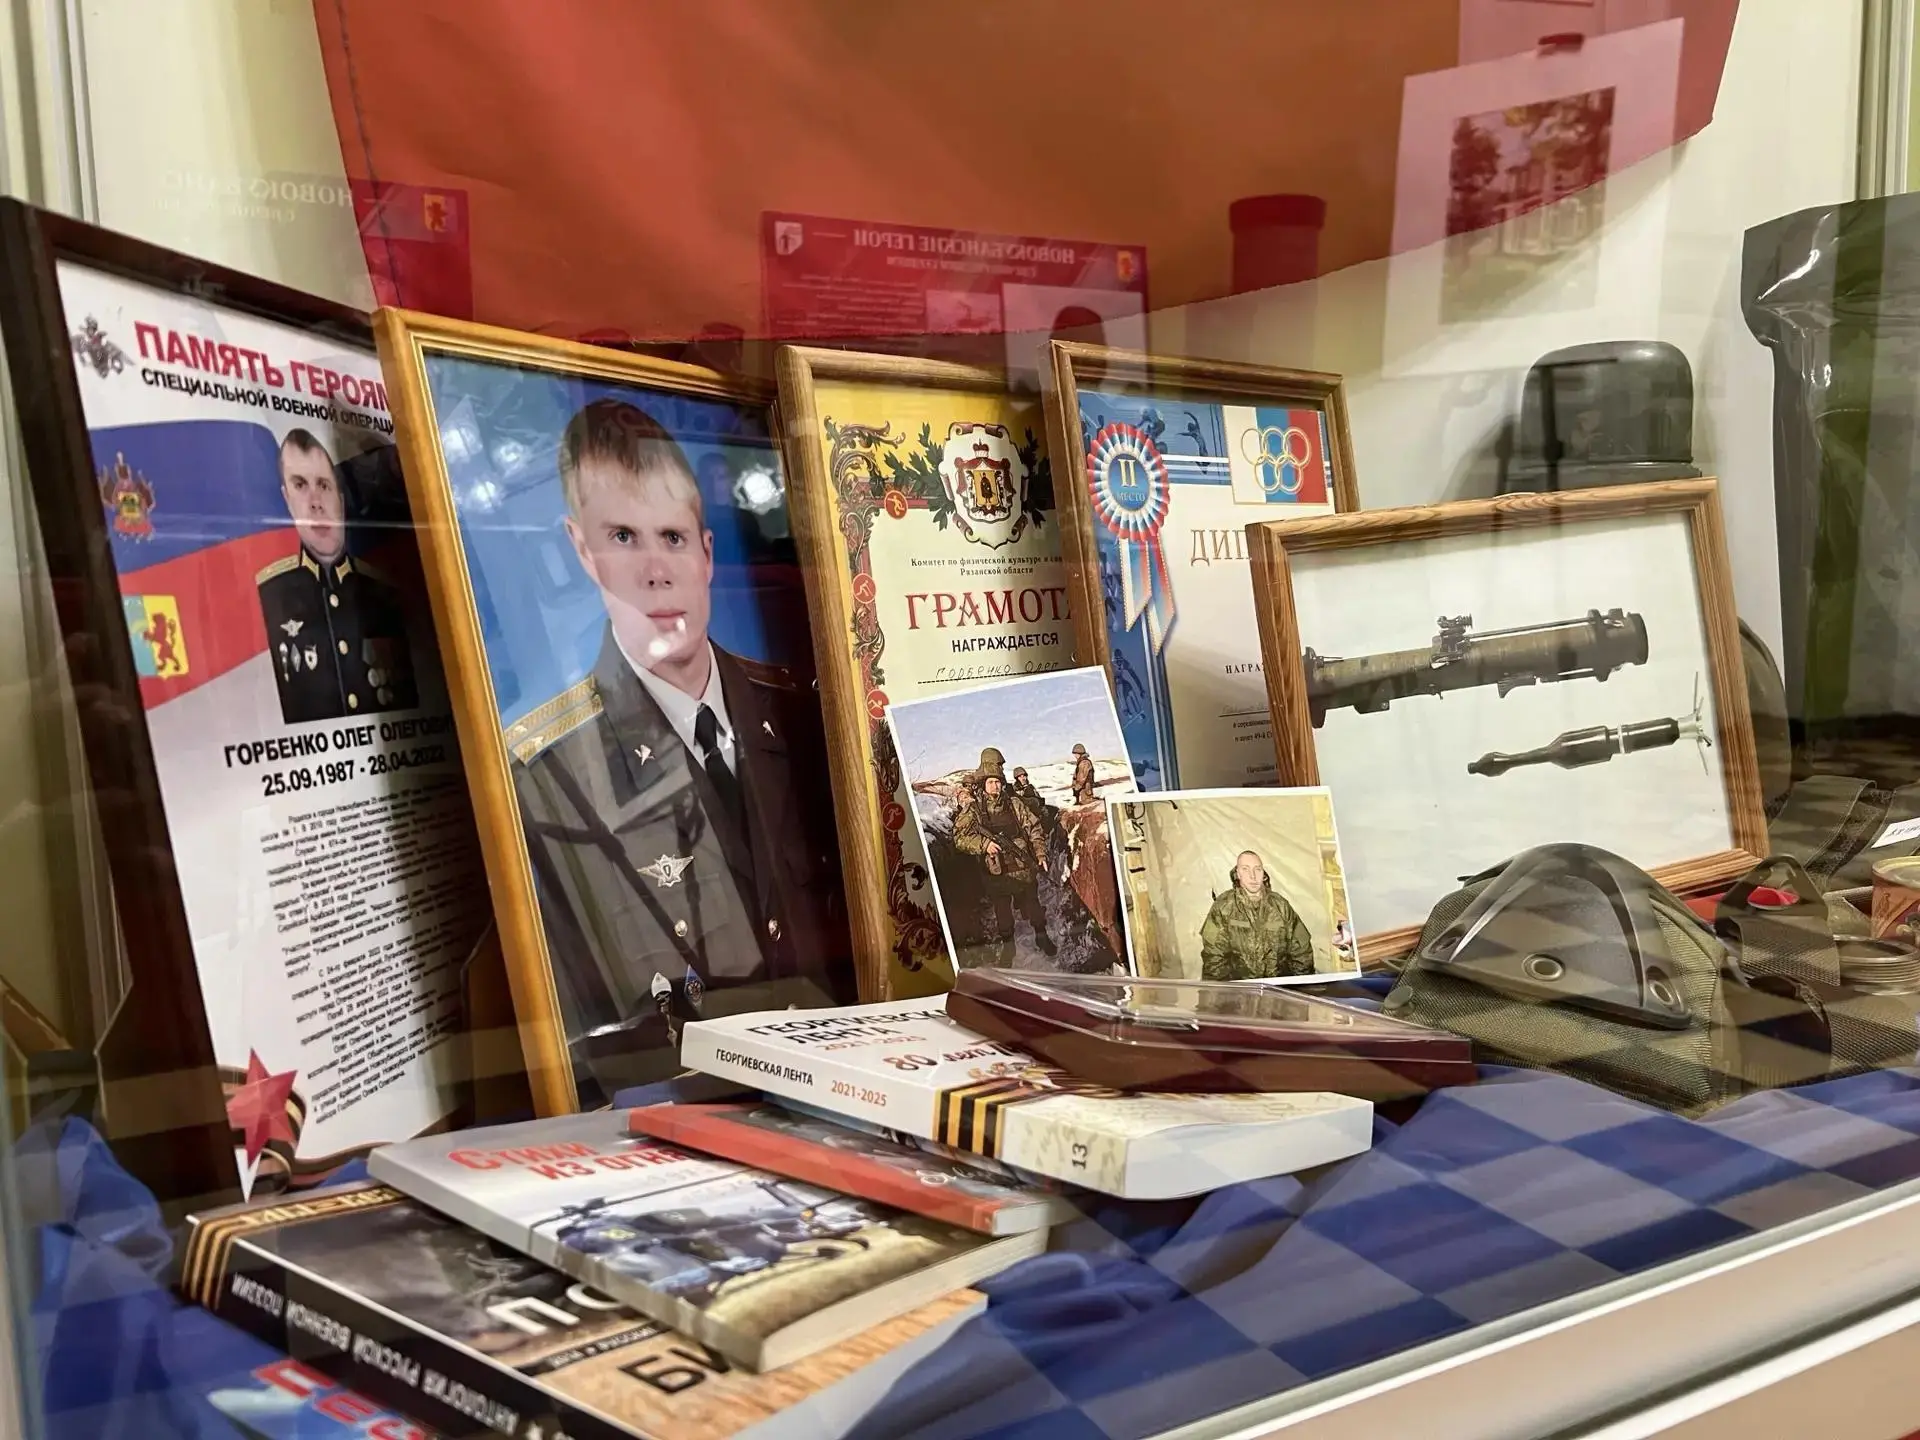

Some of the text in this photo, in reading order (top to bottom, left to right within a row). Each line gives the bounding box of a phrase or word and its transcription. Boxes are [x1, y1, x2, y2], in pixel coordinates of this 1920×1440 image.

[134, 320, 284, 389] ПАМЯТЬ
[142, 368, 269, 409] СПЕЦИАЛЬНОЙ
[270, 395, 339, 424] ВОЕННОЙ
[911, 557, 945, 567] Комитет
[948, 559, 958, 567] по
[960, 555, 1007, 568] физической
[1008, 556, 1041, 567] культуре
[960, 566, 1034, 577] Рязанской области
[952, 632, 1059, 653] НАГРАЖДАЕТСЯ
[1225, 663, 1265, 675] НАГРА
[224, 732, 329, 768] ГОРБЕНКО
[332, 725, 376, 751] ОЛЕГ
[261, 759, 355, 796] 25.09.1987
[367, 745, 446, 776] 28.04.2022
[781, 1026, 901, 1045] ЛЕНТА
[716, 1047, 814, 1087] ГЕОРГИЕВСКАЯ ЛЕНТА
[882, 1053, 939, 1071] 80
[831, 1079, 887, 1108] 2021-2025
[1072, 1143, 1089, 1171] 13
[284, 1298, 352, 1353] ВОЕННОЙ
[352, 1331, 421, 1388] РУССКОЙ
[422, 1369, 520, 1436] АНТОЛОГИЯ
